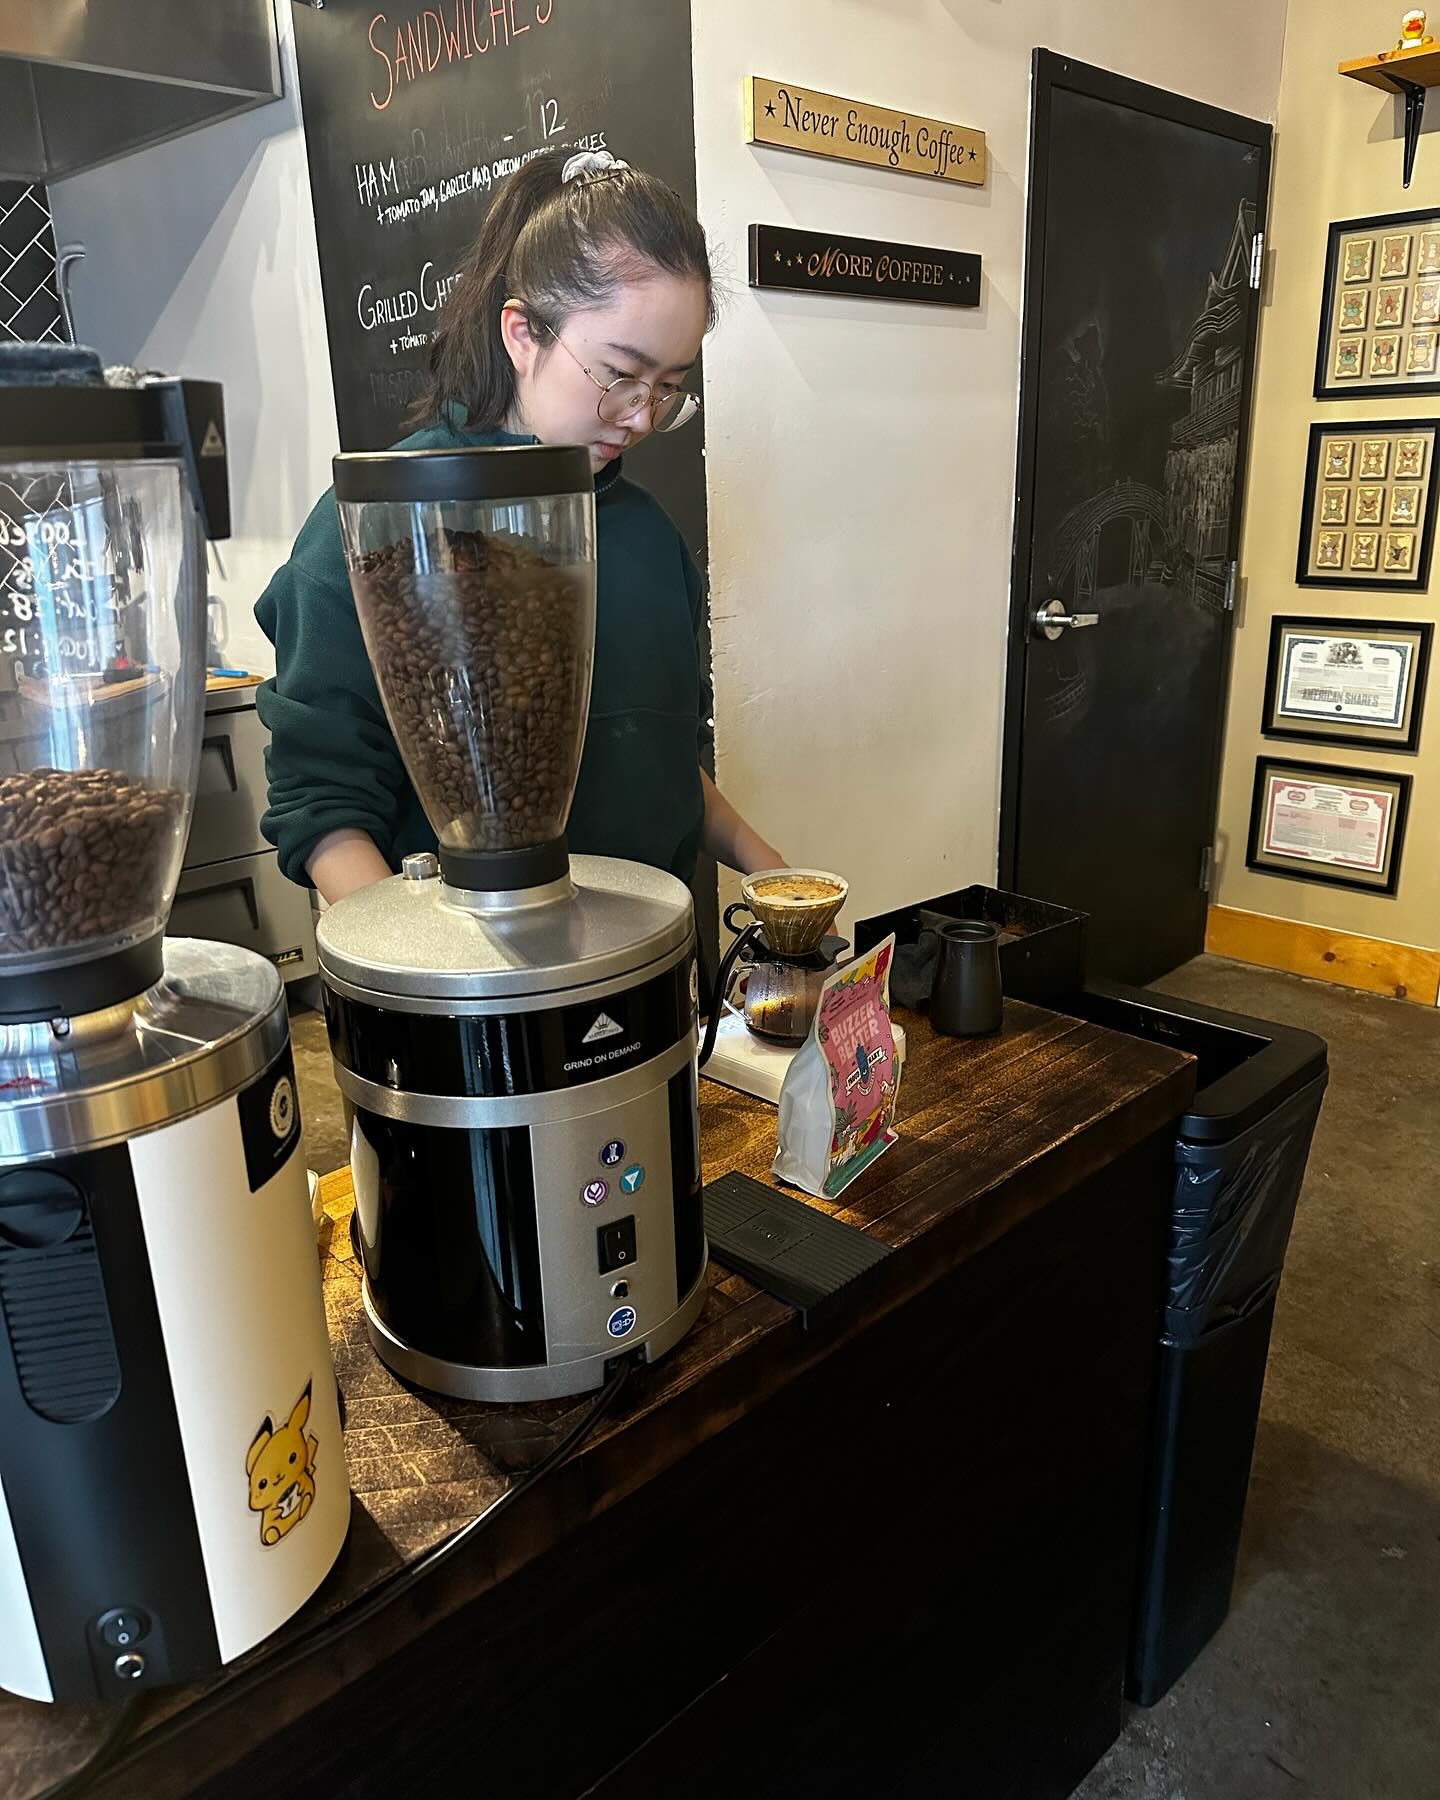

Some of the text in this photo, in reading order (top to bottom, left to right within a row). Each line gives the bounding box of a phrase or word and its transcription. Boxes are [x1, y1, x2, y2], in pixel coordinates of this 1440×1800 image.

[355, 157, 399, 207] HAM
[540, 99, 566, 140] 12
[778, 89, 965, 175] Never Enough Coffee
[386, 198, 420, 224] TOMATO
[440, 171, 473, 202] GARLIC
[807, 246, 944, 286] MORE COFFEE
[357, 284, 419, 330] GRILLED
[1303, 688, 1379, 707] AMERICAN SHARES
[830, 999, 876, 1047] BUZZER
[837, 1018, 880, 1067] BEATER
[563, 1042, 641, 1072] GRIND ON DEMAND
